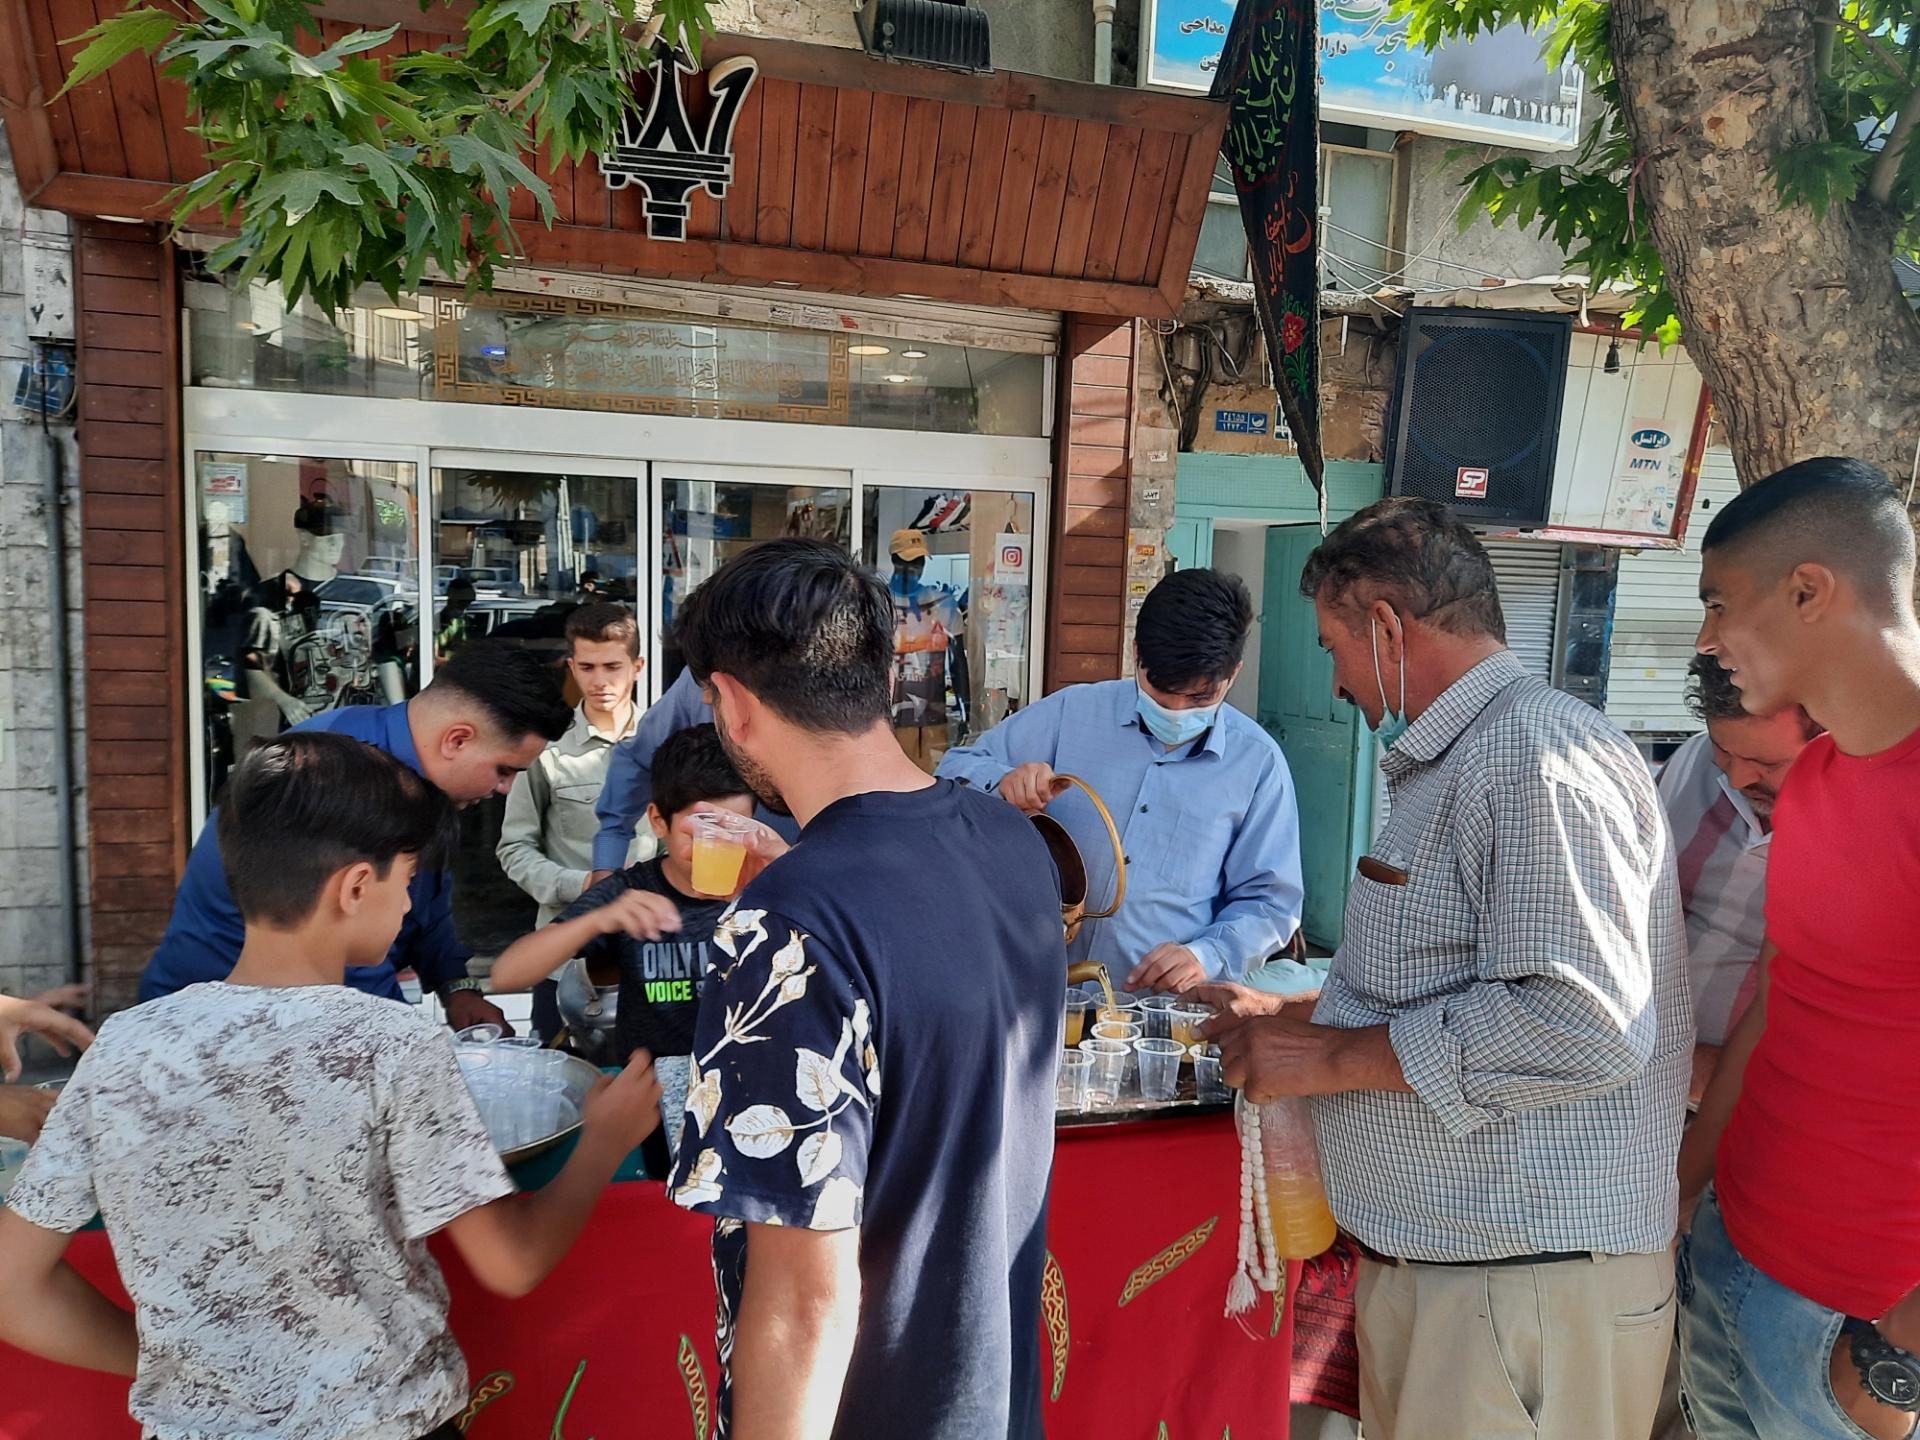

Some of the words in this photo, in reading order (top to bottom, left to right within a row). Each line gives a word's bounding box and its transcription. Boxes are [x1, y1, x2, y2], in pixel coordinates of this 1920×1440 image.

[1634, 432, 1668, 448] ایرانسل
[1629, 458, 1662, 470] MTN
[1459, 471, 1485, 488] SP
[642, 942, 692, 979] ONLY
[644, 981, 693, 1003] VOICE
